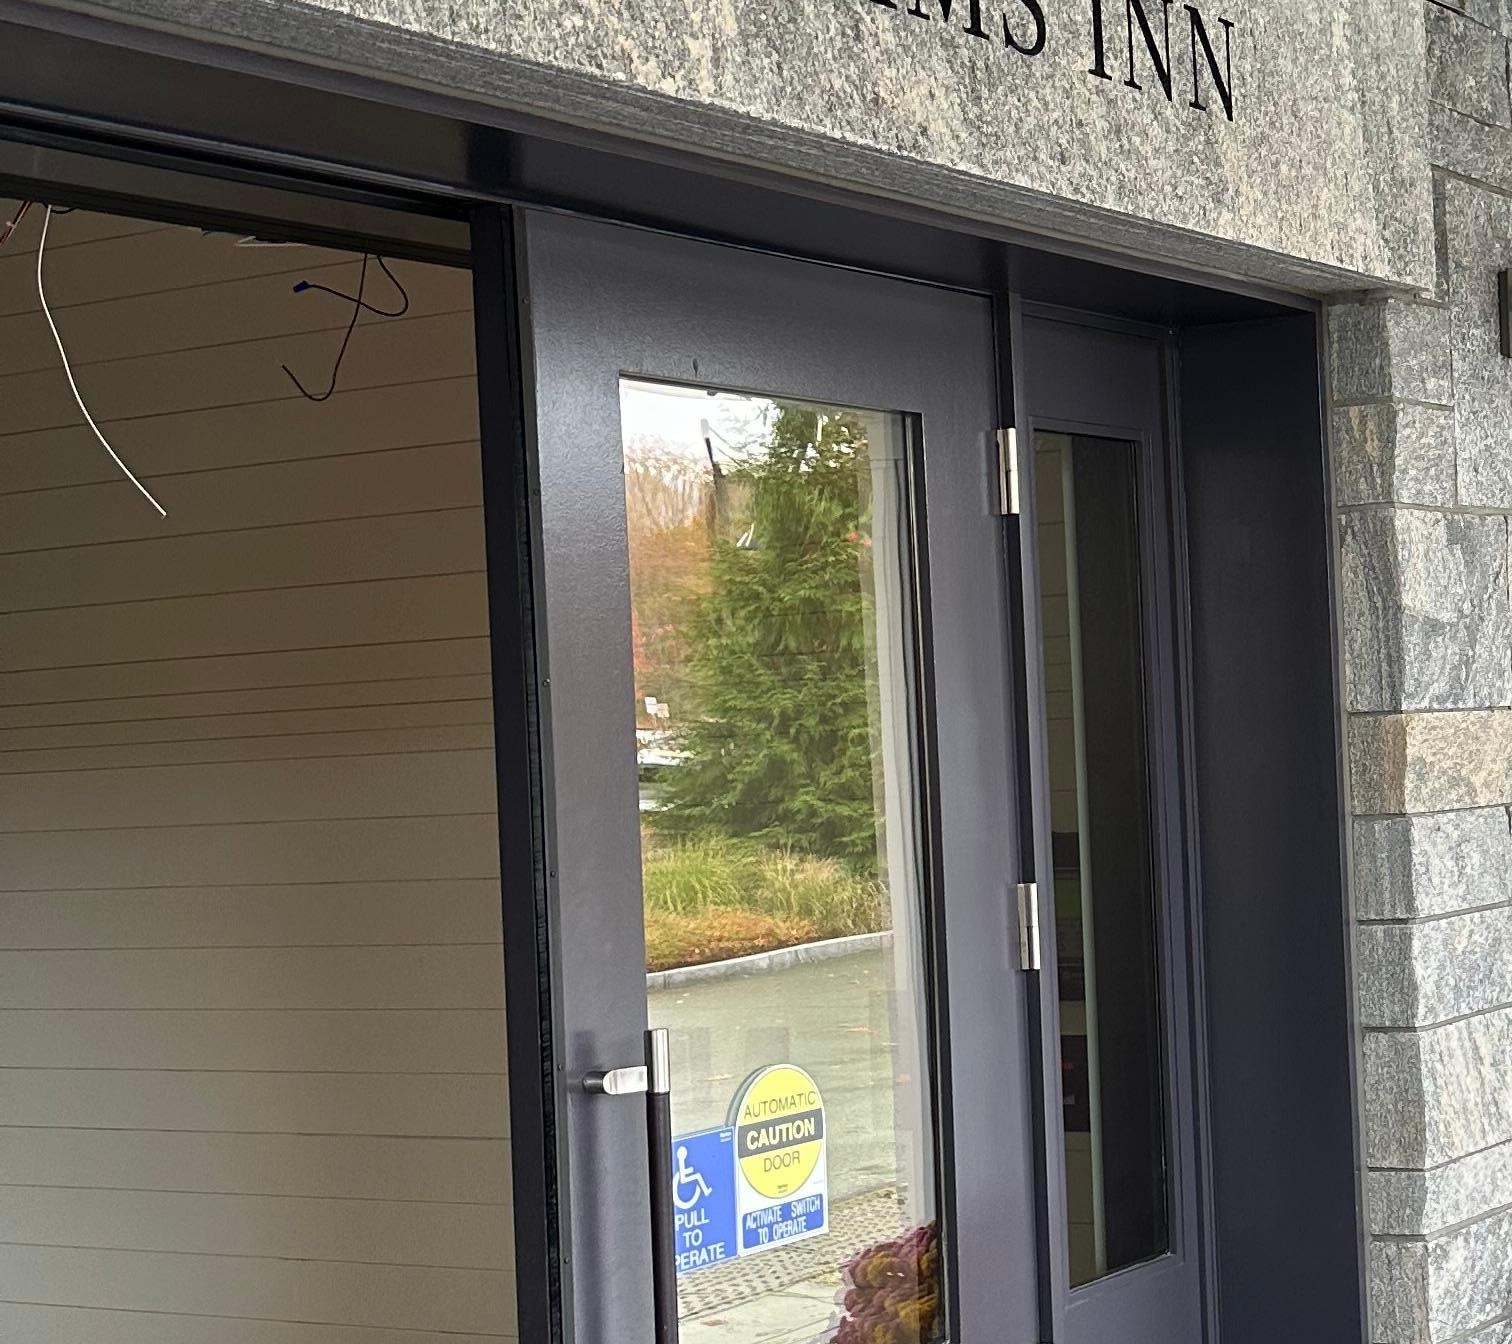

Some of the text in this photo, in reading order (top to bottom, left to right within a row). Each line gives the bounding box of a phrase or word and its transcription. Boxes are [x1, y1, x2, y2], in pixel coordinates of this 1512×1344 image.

[743, 1090, 815, 1120] AUTOMATIC
[746, 1116, 815, 1150] CAUTION
[763, 1150, 800, 1172] DOOR
[675, 1207, 710, 1231] PULL
[745, 1195, 820, 1230] ACTIVATE SWITCH
[682, 1228, 702, 1248] TO
[757, 1215, 806, 1244] TO OPERATE
[674, 1241, 725, 1270] PERATE
